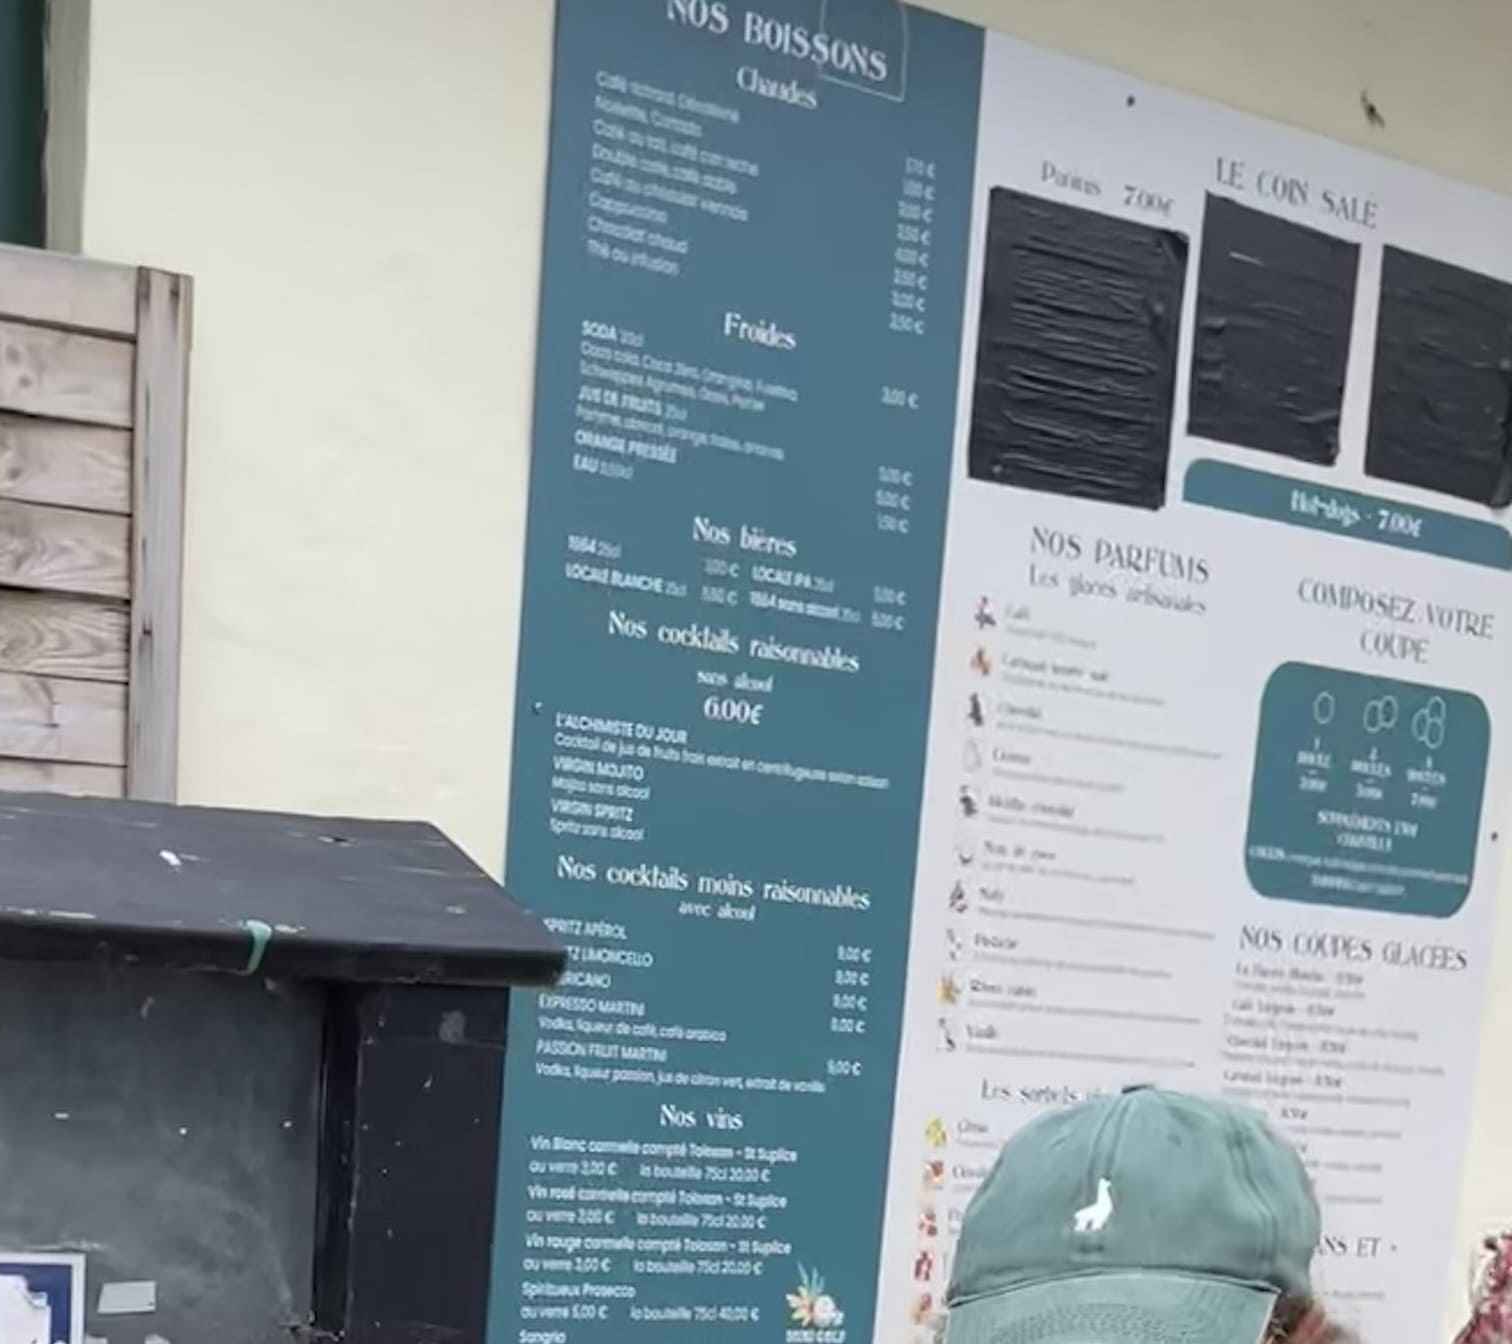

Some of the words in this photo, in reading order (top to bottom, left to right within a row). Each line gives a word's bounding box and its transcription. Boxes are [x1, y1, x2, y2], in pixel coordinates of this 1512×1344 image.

[666, 0, 729, 34] NOS
[742, 11, 888, 81] BOISSONS
[737, 65, 818, 109] Chaudes
[1216, 156, 1245, 190] LE
[1256, 170, 1310, 206] COIN
[724, 312, 796, 350] Froides
[692, 515, 731, 546] Nos
[739, 524, 797, 558] bières
[1031, 525, 1082, 560] NOS
[1095, 538, 1210, 584] PARFUMS
[1030, 562, 1059, 588] Les
[1298, 577, 1416, 624] COMPOSEZ
[1425, 604, 1495, 640] VOTRE
[608, 609, 647, 640] Nos
[657, 623, 739, 655] cocktails
[749, 636, 860, 673] raisonnables
[1359, 631, 1429, 665] COUPE
[557, 854, 597, 881] Nos
[606, 863, 689, 893] cocktails
[697, 872, 754, 900] moins
[762, 878, 872, 911] raisonnables
[1239, 923, 1283, 951] NOS
[1293, 931, 1373, 961] COUPES
[660, 1103, 697, 1128] Nos
[706, 1106, 744, 1130] vins
[1356, 1236, 1381, 1258] ET
